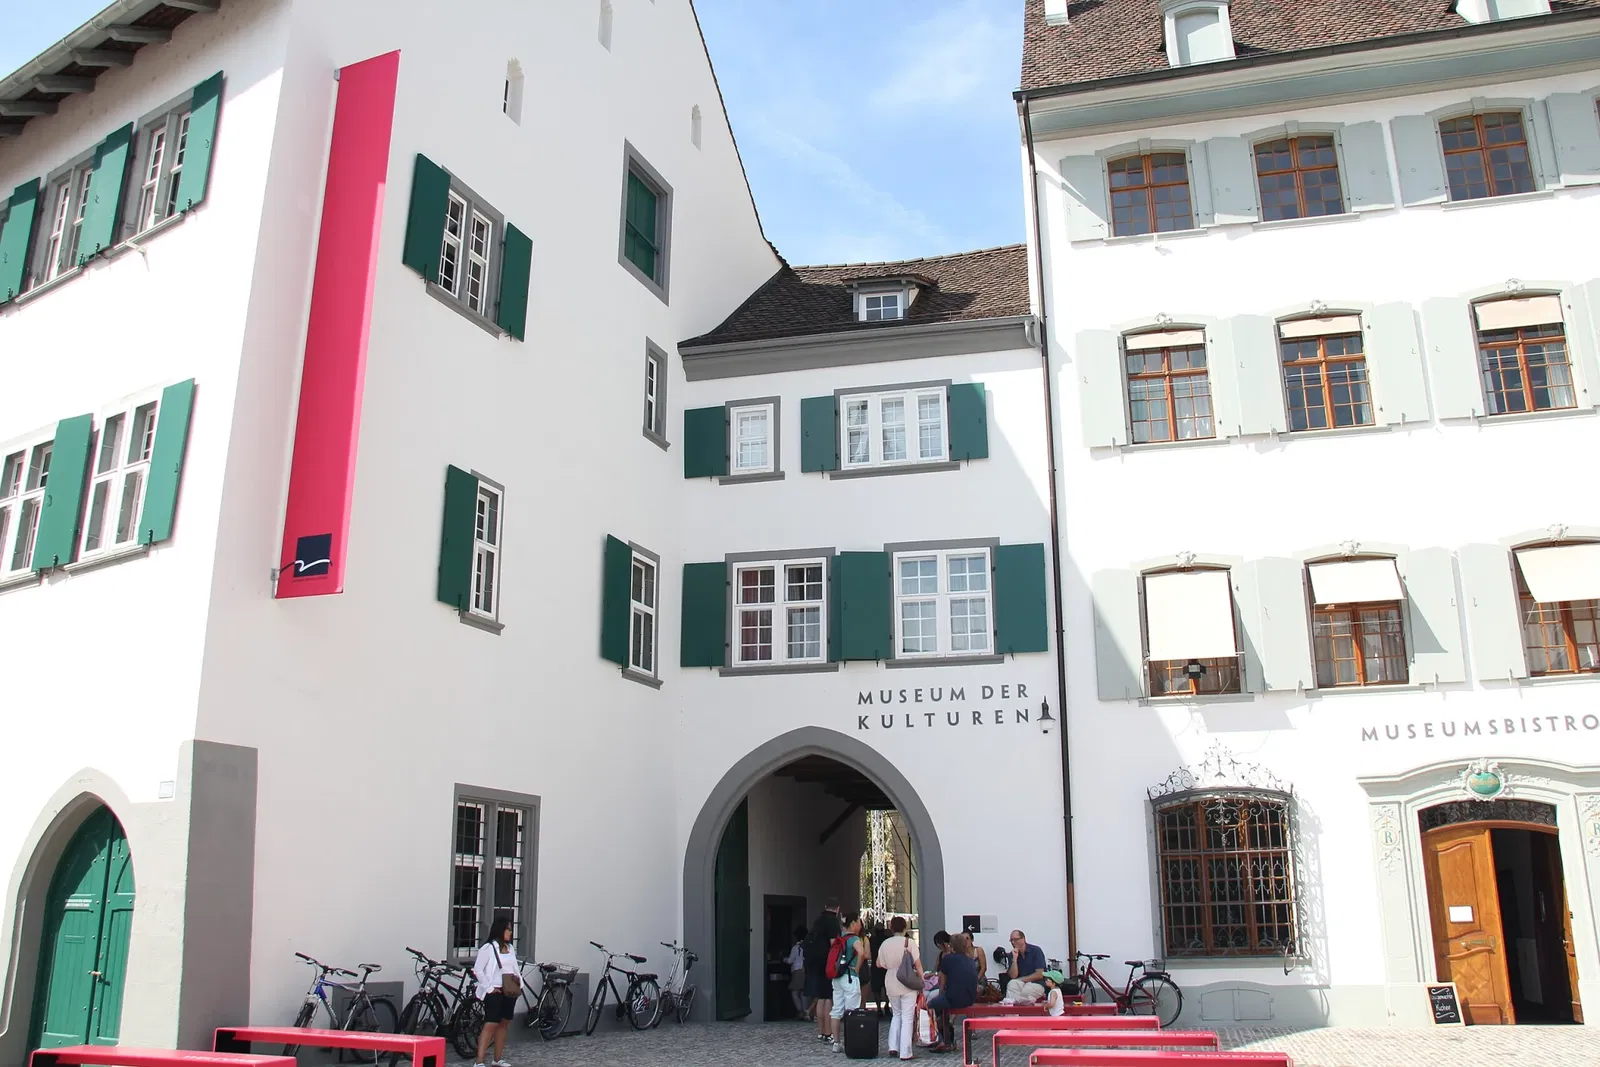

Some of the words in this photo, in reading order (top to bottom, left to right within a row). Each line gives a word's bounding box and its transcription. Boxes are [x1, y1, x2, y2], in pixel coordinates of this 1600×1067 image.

[857, 687, 966, 705] MUSEUM
[981, 683, 1029, 700] DER
[858, 708, 1029, 730] KULTUREN
[1361, 714, 1600, 741] MUSEUMSBISTRO
[1384, 831, 1393, 844] R
